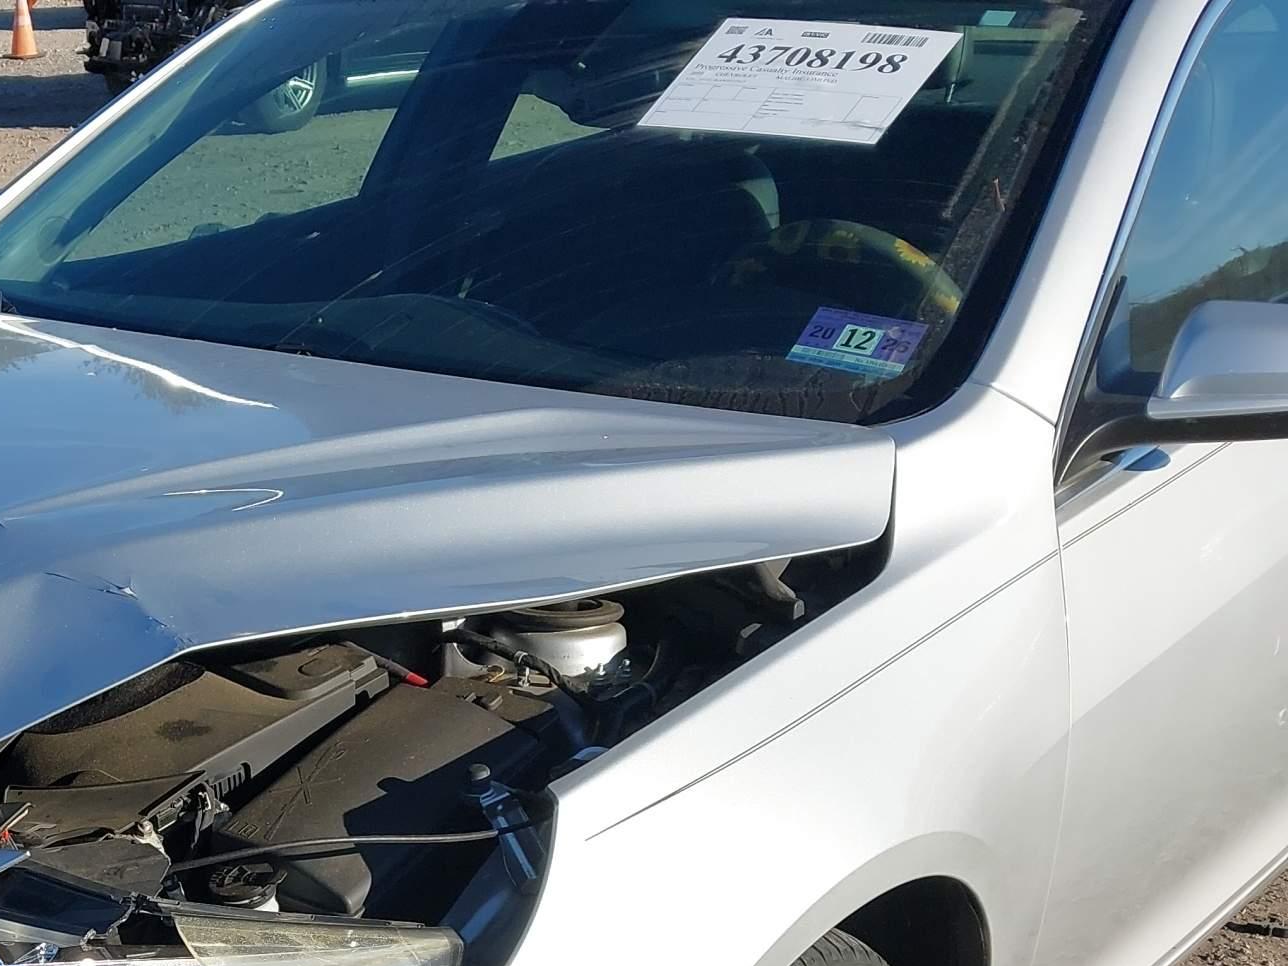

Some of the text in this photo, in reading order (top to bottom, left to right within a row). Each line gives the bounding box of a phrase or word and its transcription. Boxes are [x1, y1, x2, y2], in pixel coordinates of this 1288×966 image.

[717, 43, 908, 74] 43708198
[750, 65, 788, 75] Casualty
[791, 67, 839, 79] Insurance
[809, 325, 912, 354] 20 12 26
